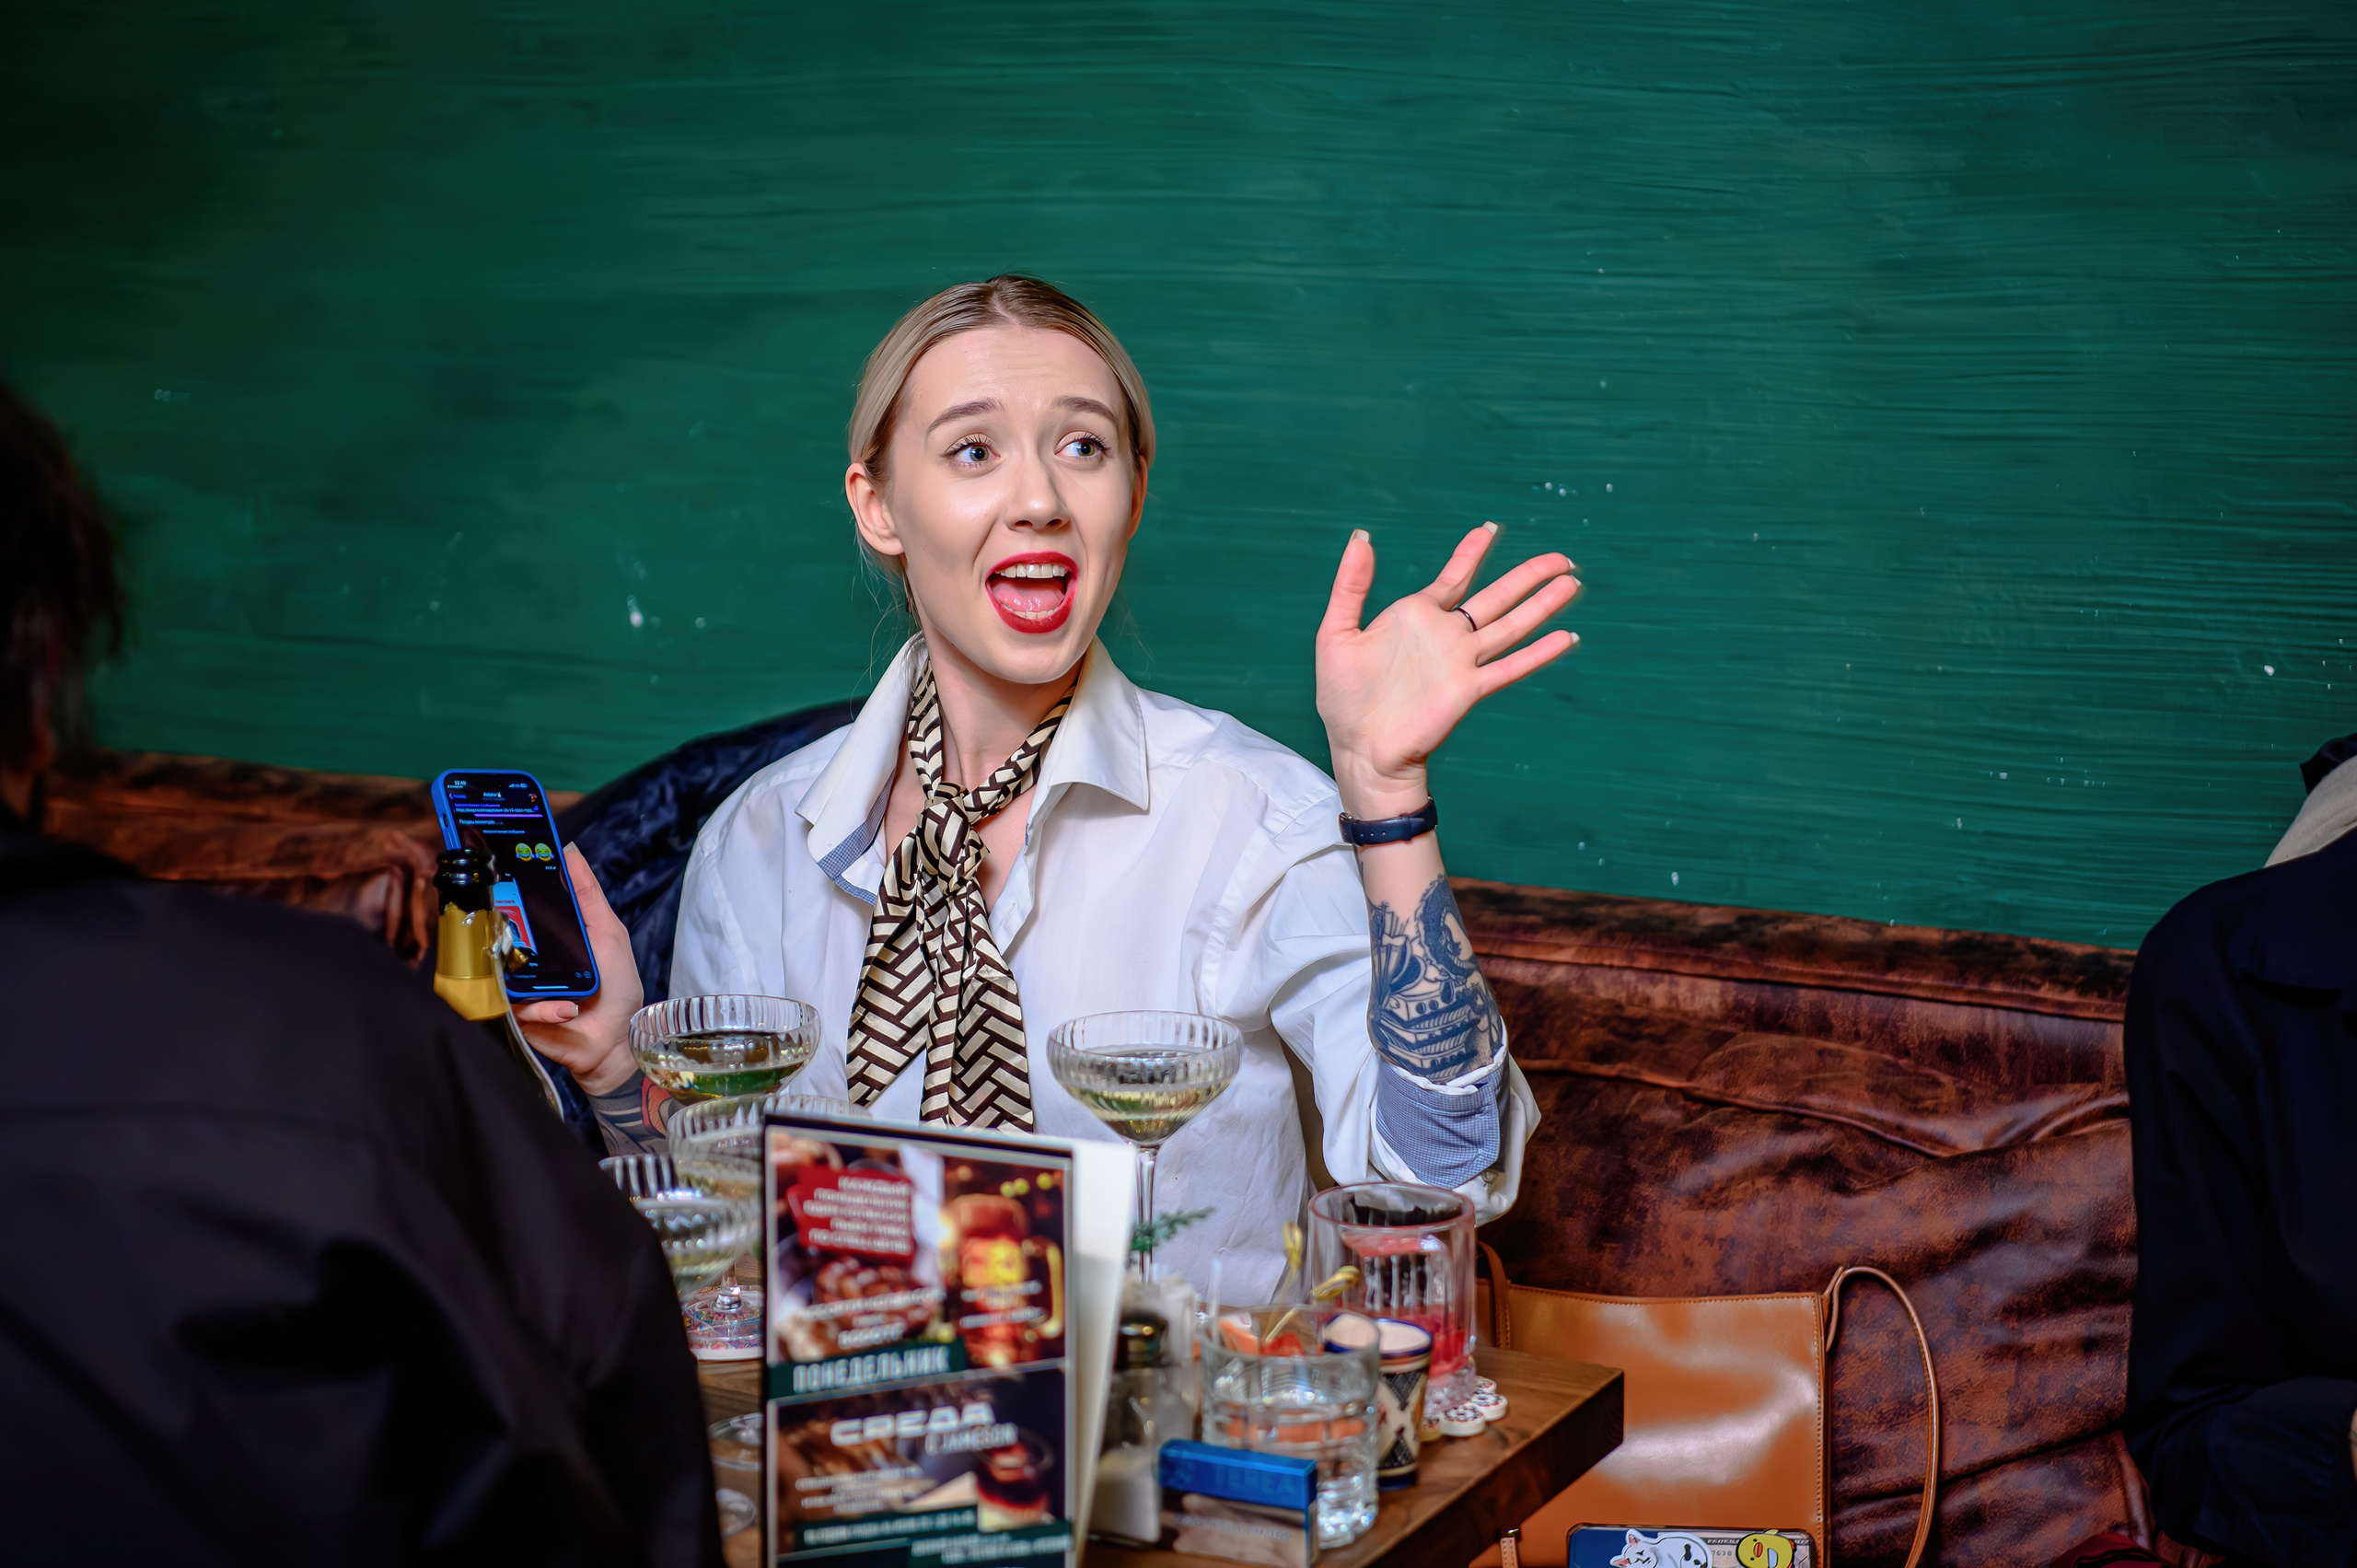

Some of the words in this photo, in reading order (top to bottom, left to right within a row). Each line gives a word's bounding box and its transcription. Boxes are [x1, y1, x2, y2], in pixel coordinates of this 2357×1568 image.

[793, 1345, 950, 1394] ПОНЕДЕЛЬНИК
[830, 1401, 995, 1446] СРЕДА
[940, 1423, 1019, 1455] JAMESON
